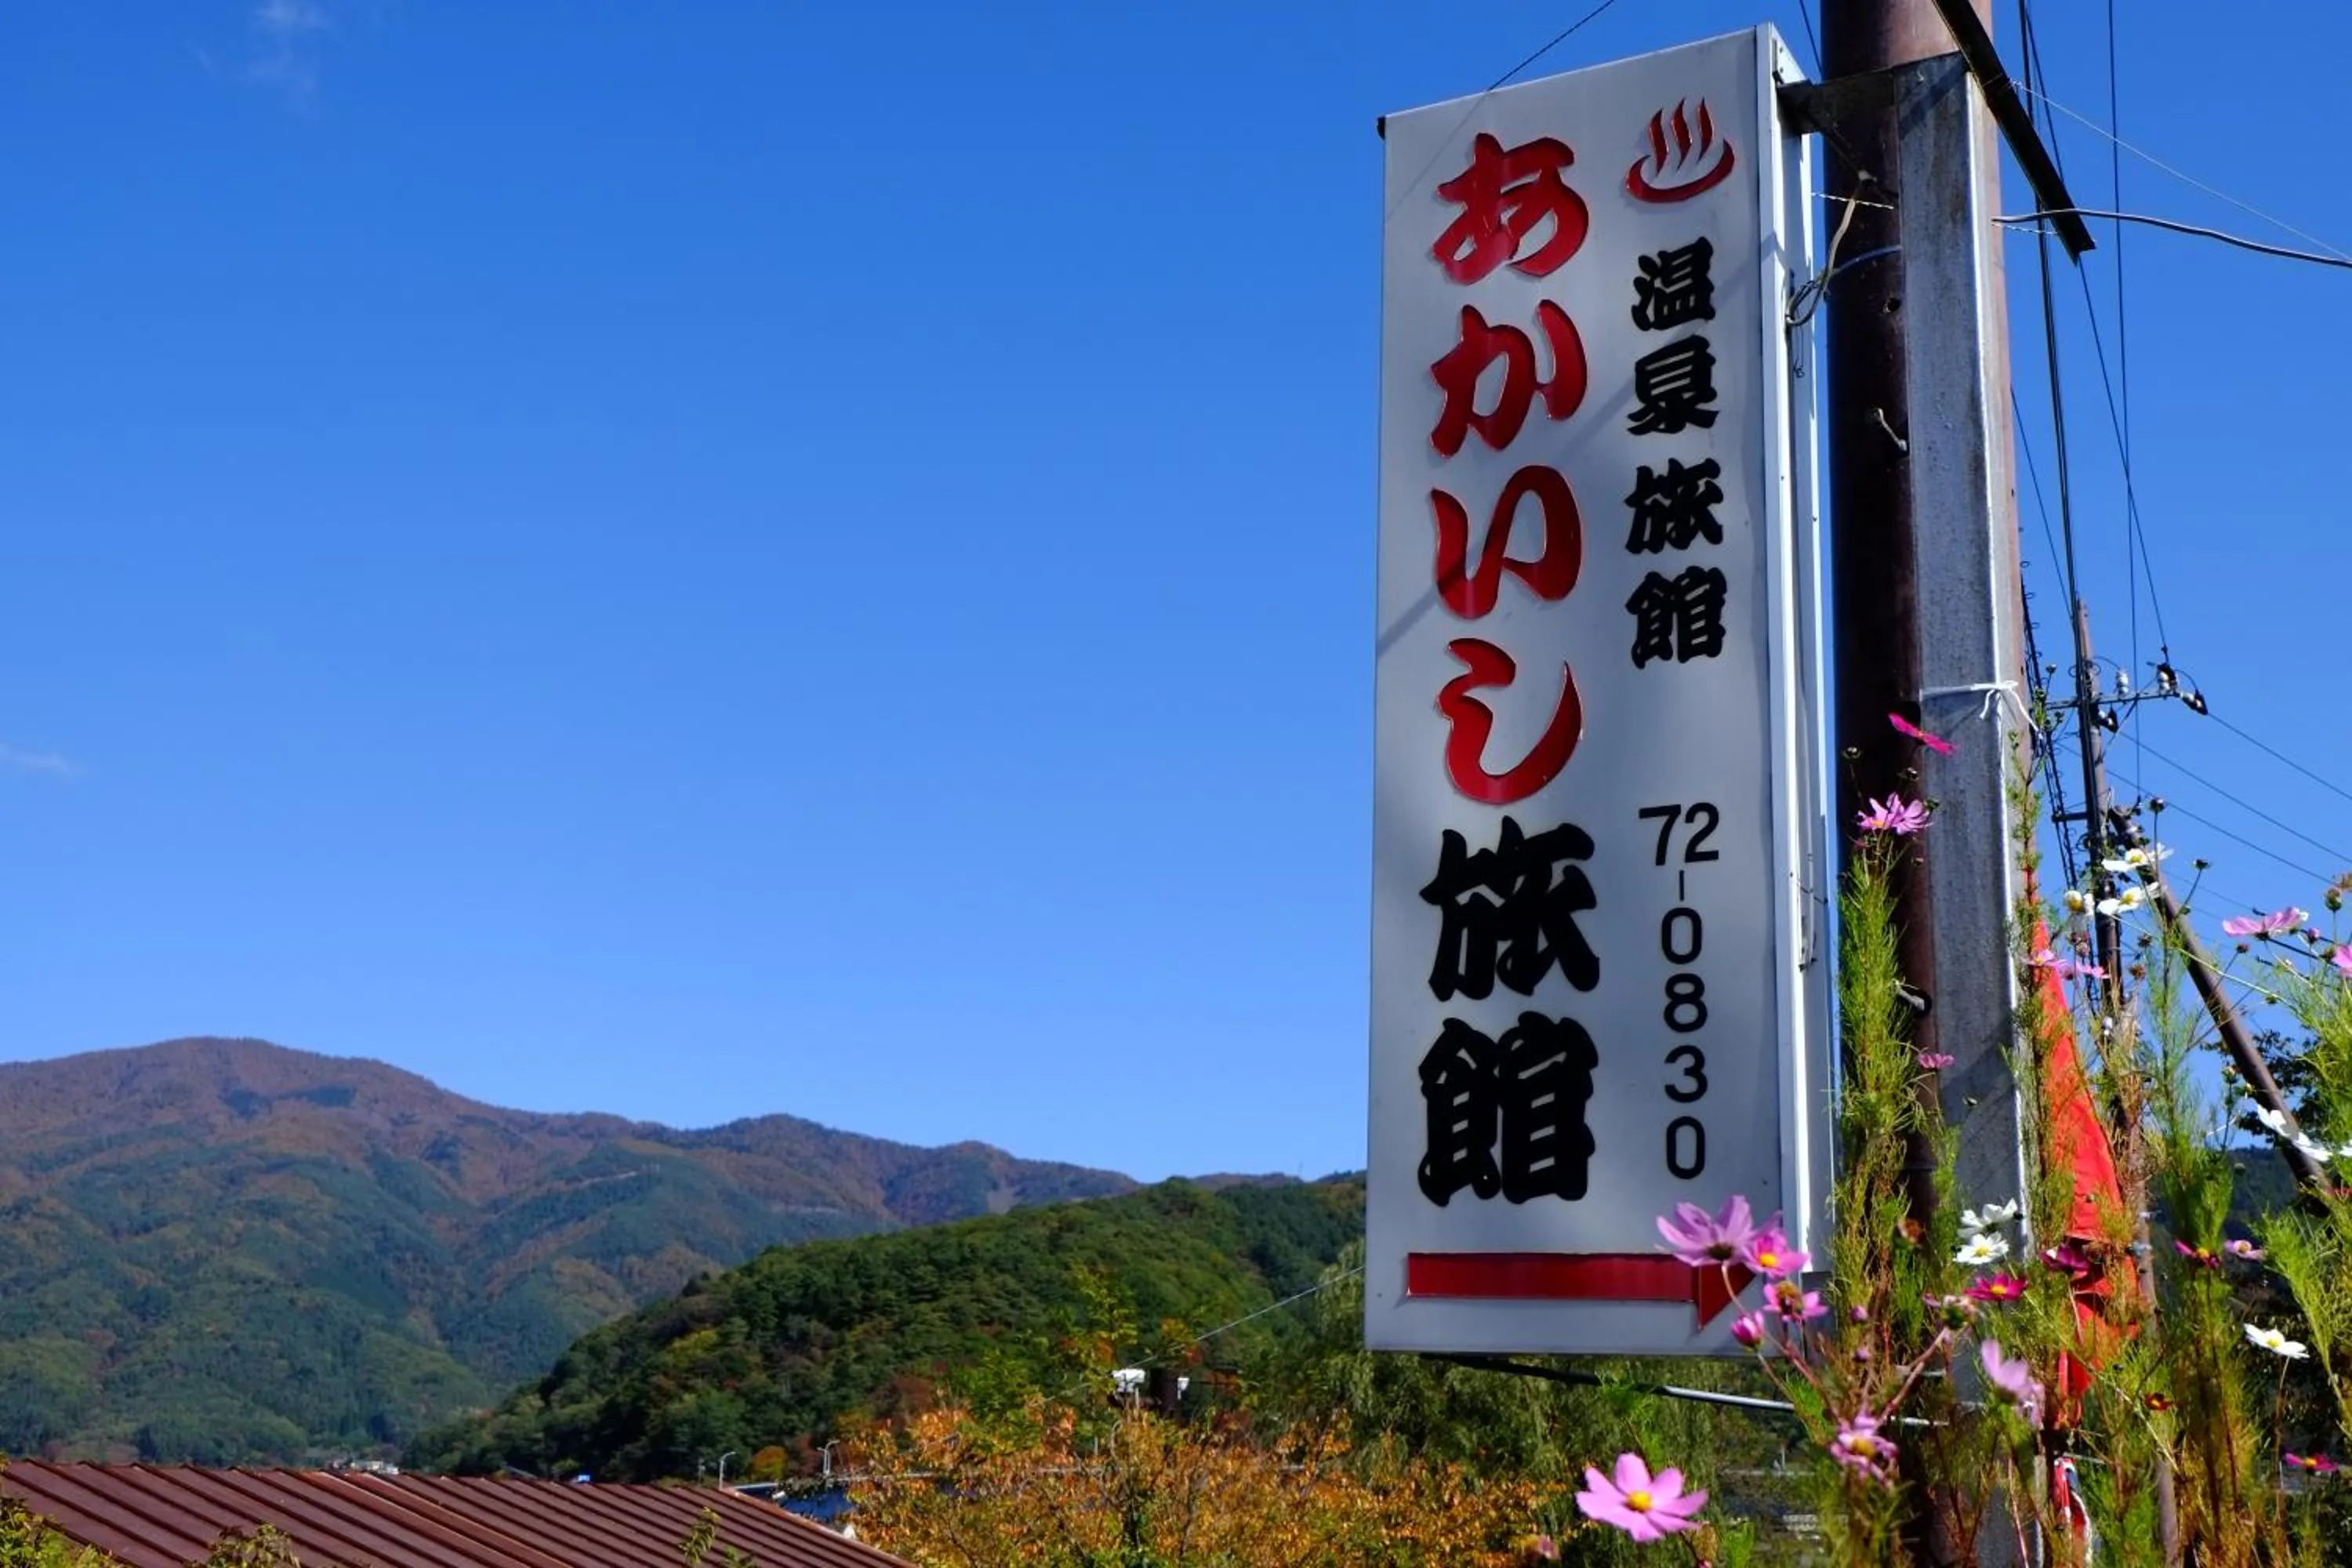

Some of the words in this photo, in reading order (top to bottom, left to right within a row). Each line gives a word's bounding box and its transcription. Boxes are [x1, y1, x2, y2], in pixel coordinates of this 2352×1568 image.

[1624, 237, 1727, 669] 温泉旅館
[1418, 132, 1600, 1207] あかいし旅館
[1638, 802, 1720, 1180] 72-0830
